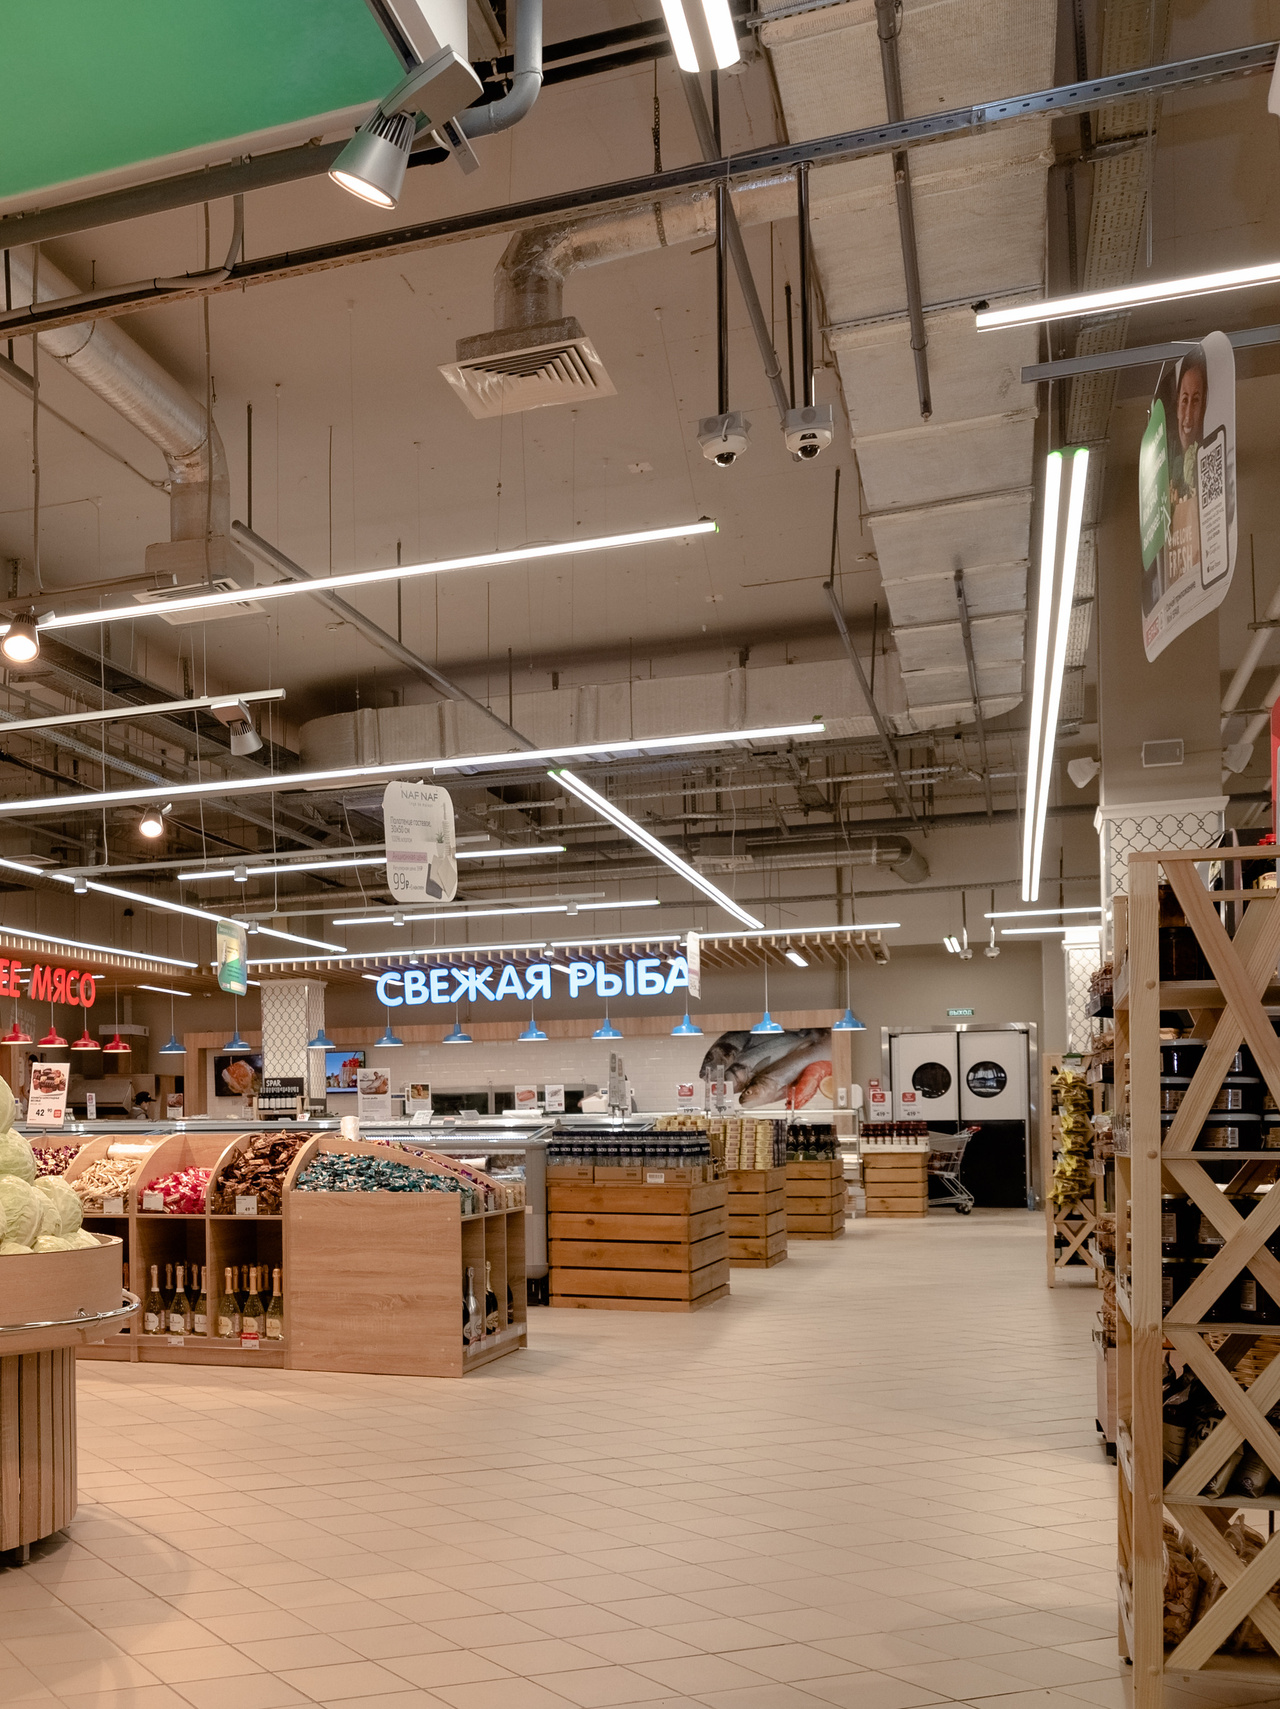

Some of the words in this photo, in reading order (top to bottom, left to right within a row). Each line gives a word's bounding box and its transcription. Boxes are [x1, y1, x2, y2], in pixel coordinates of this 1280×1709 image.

[1168, 545, 1193, 578] FRESH
[401, 790, 419, 800] NAF
[421, 792, 438, 802] NAF
[30, 963, 96, 1008] МЯСО
[376, 964, 552, 1007] СВЕЖАЯ
[569, 956, 689, 999] РЫБА
[36, 1109, 45, 1117] 42
